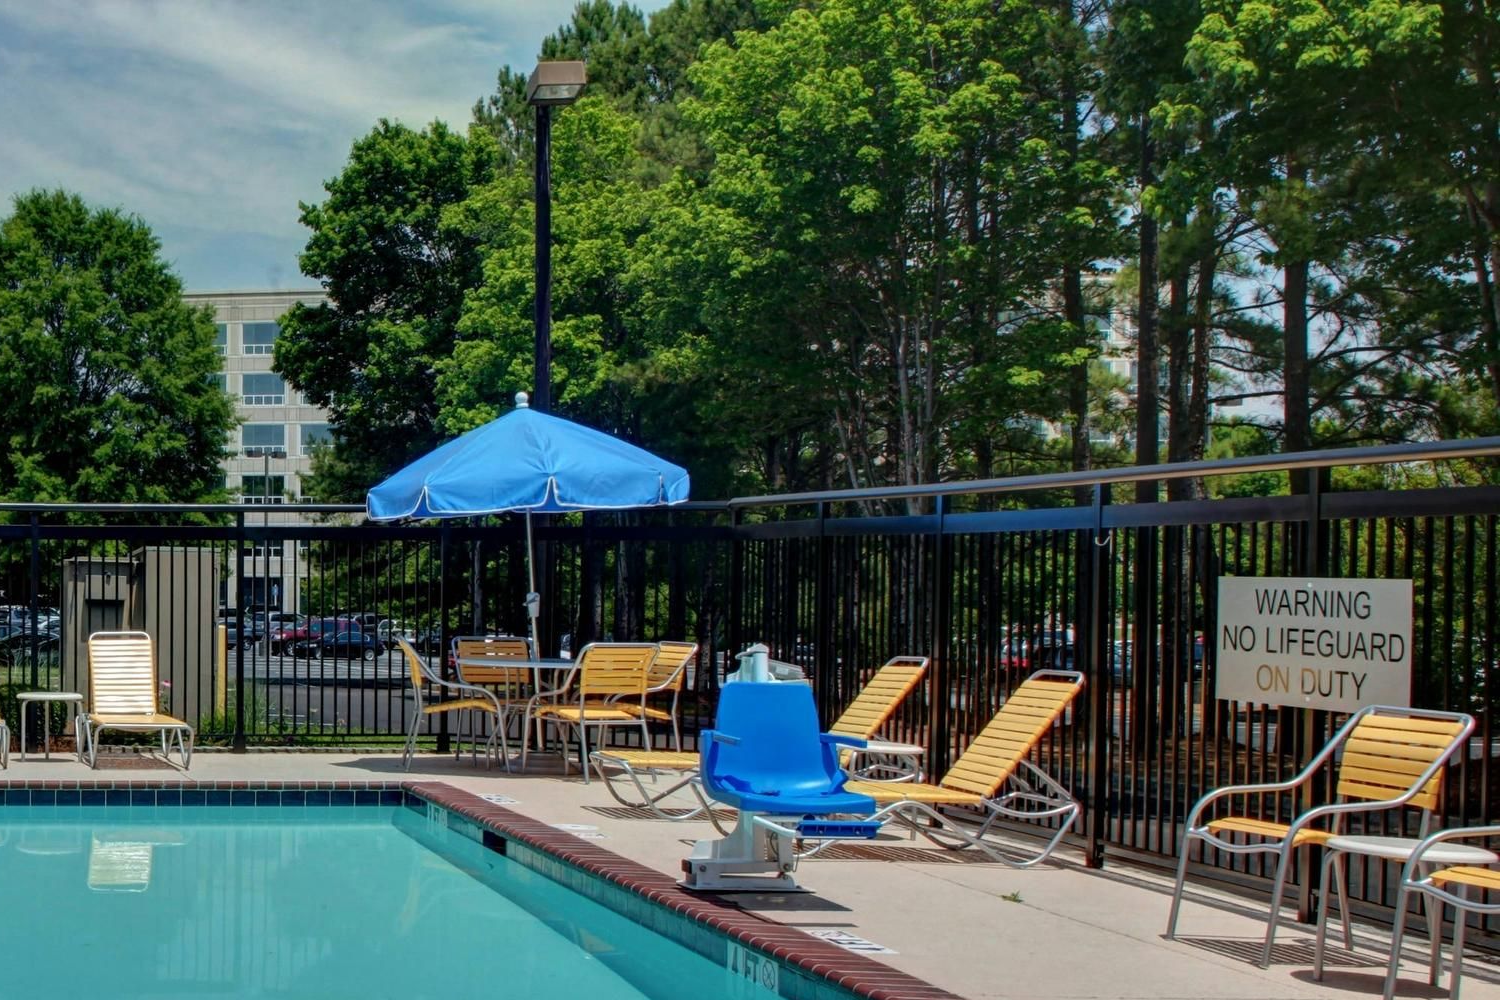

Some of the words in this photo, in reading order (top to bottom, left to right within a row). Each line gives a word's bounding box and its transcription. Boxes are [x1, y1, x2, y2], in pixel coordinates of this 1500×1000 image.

[1255, 589, 1371, 619] WARNING
[1223, 625, 1256, 652] NO
[1266, 627, 1405, 663] LIFEGUARD
[1256, 664, 1290, 693] ON
[1301, 668, 1368, 700] DUTY
[744, 950, 760, 984] FT
